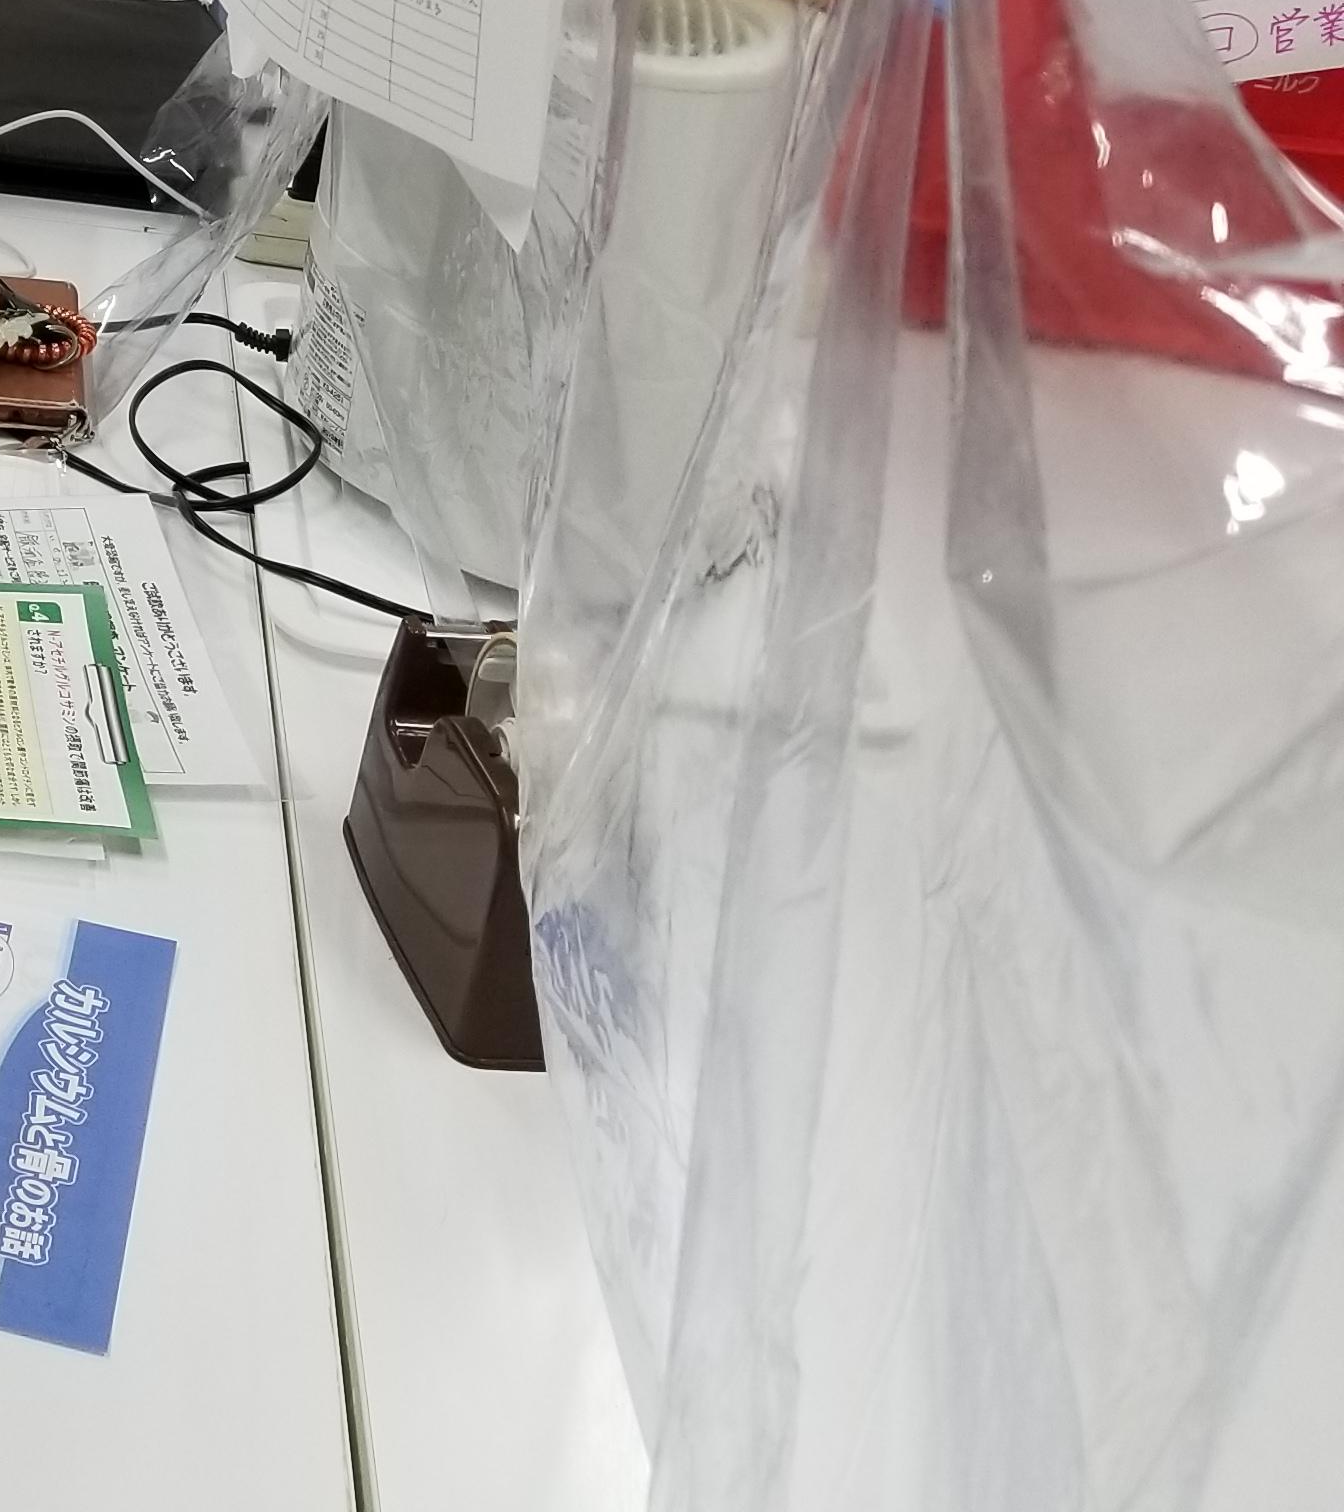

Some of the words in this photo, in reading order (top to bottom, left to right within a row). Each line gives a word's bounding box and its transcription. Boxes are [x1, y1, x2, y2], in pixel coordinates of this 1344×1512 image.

[26, 628, 49, 675] されますか?
